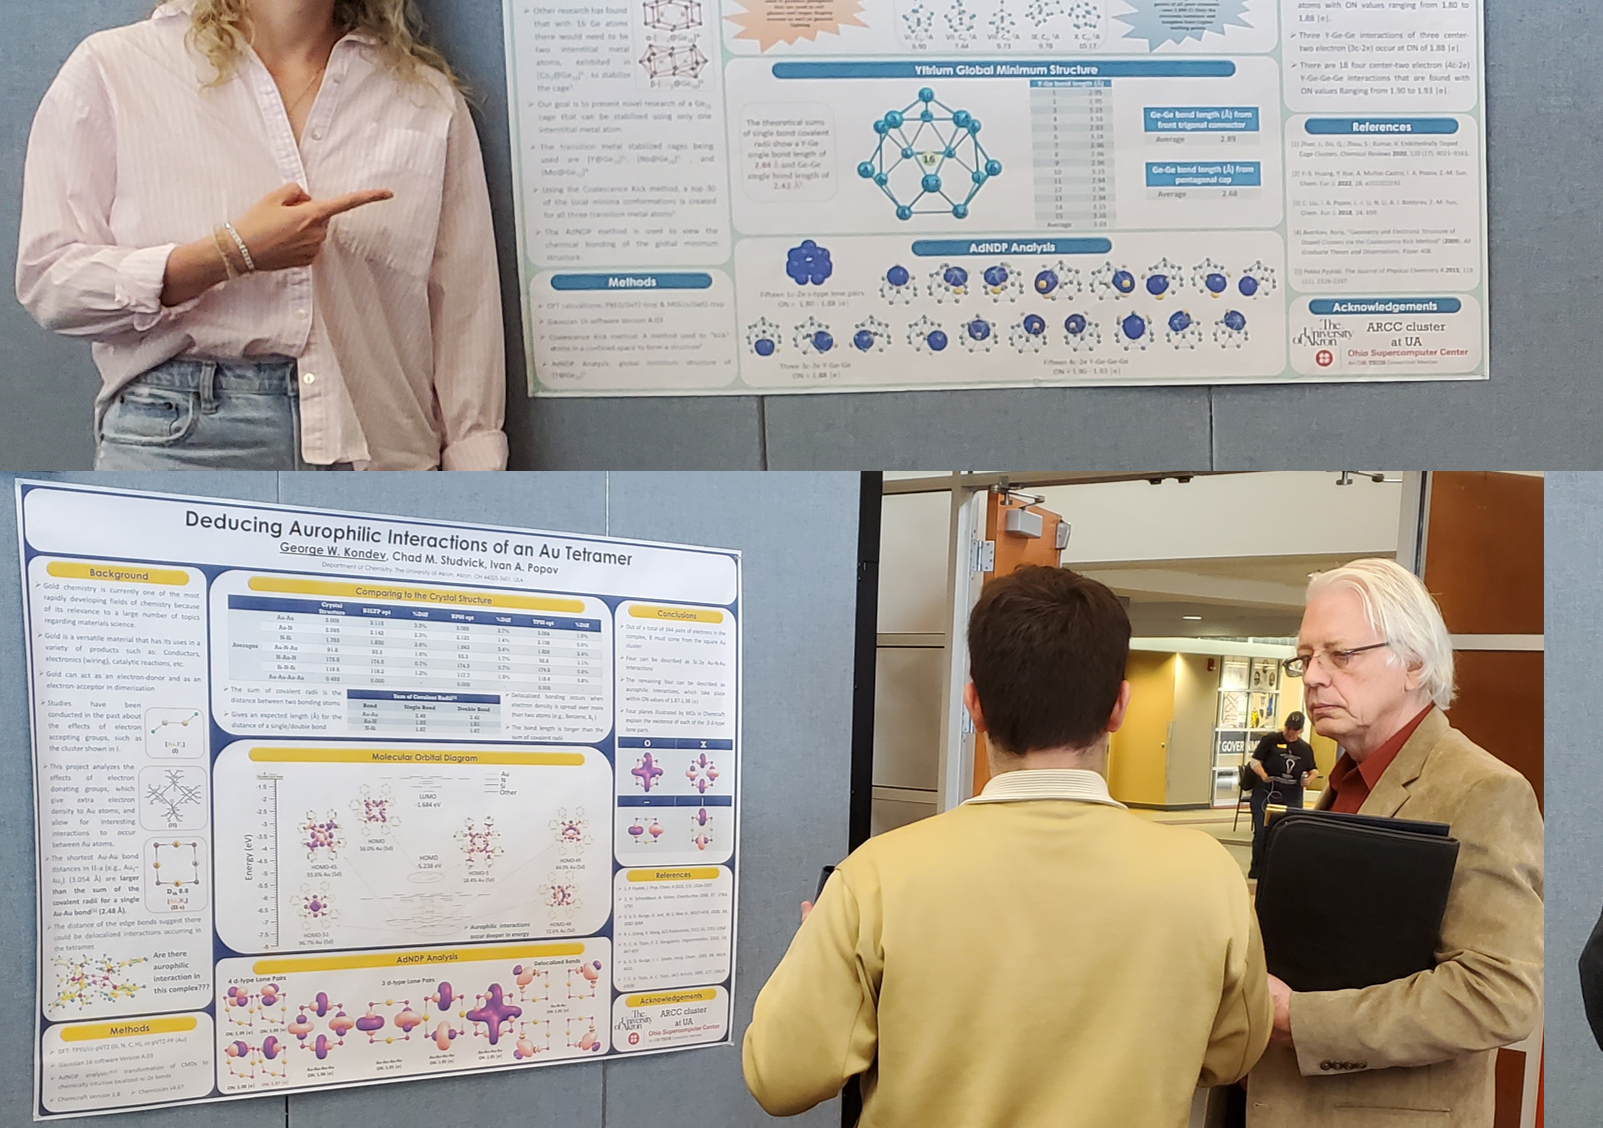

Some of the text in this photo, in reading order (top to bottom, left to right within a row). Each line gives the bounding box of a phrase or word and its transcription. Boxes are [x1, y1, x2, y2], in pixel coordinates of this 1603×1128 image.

[914, 64, 1099, 76] Yttrium Global Minimum Structure
[1352, 121, 1412, 133] References
[969, 241, 1056, 254] AdNDP Analysis
[607, 276, 657, 289] Methods
[1332, 302, 1438, 314] Acknowledgements
[186, 510, 633, 566] Deducing Aurophilic Interactions of an Au Tetramer
[89, 568, 150, 581] Background
